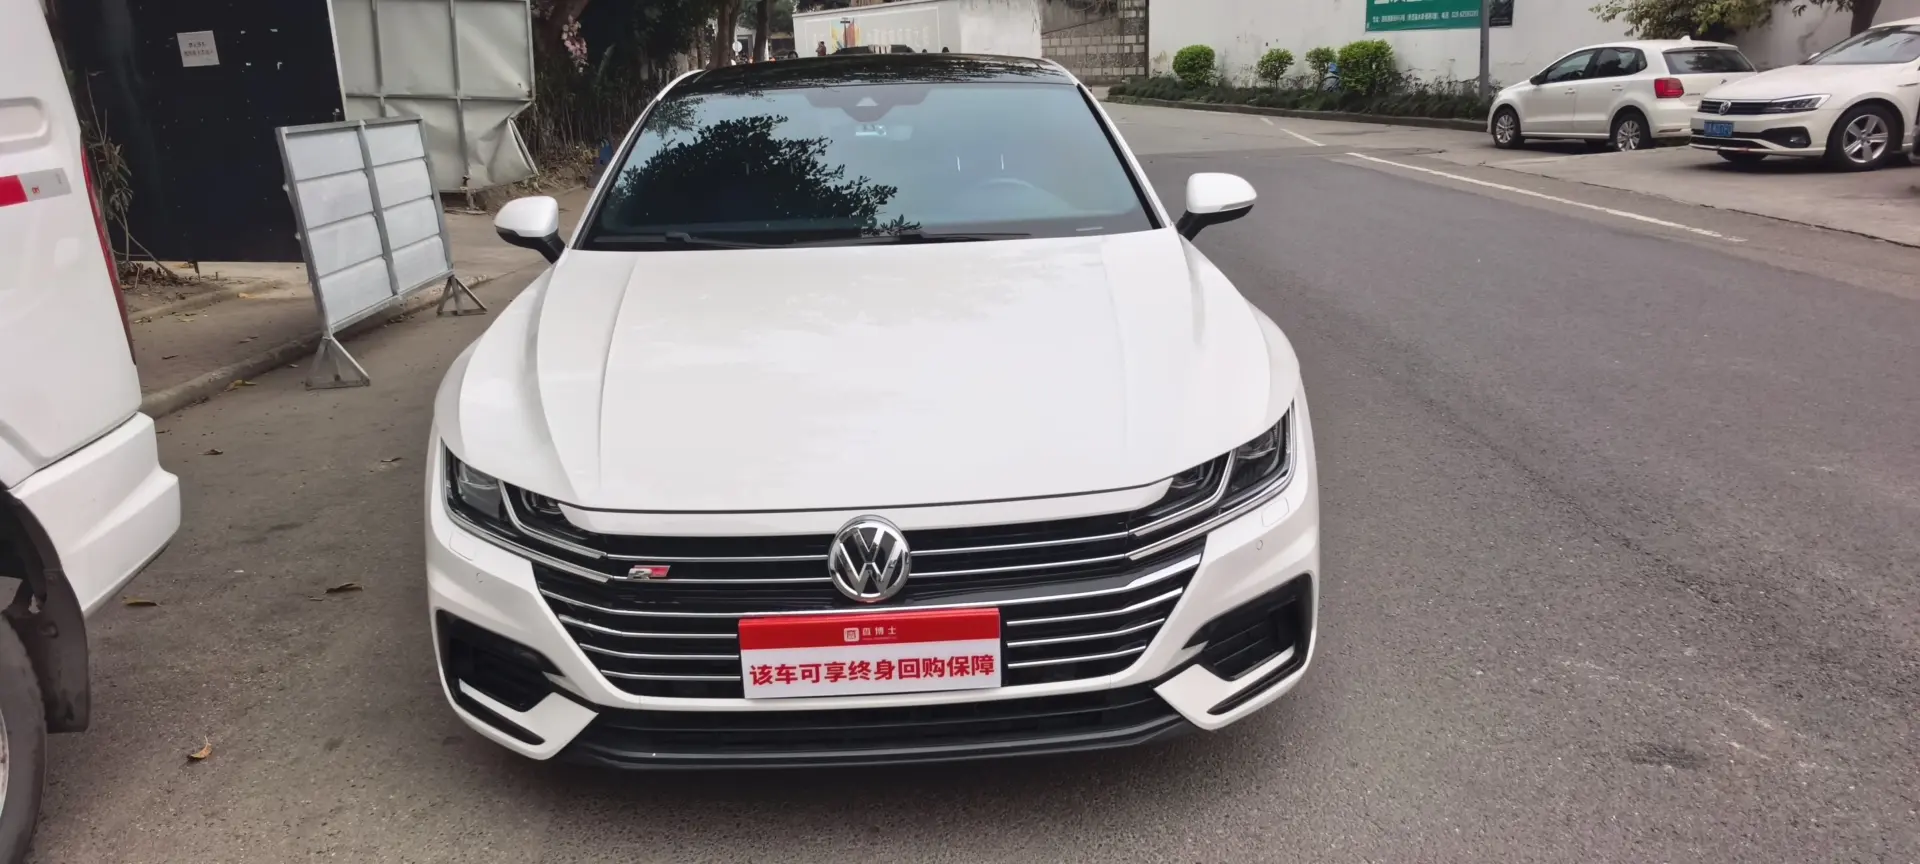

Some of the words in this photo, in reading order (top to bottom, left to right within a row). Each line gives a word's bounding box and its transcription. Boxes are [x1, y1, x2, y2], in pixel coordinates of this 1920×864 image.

[750, 654, 995, 686] 该车可享终身回购保障
